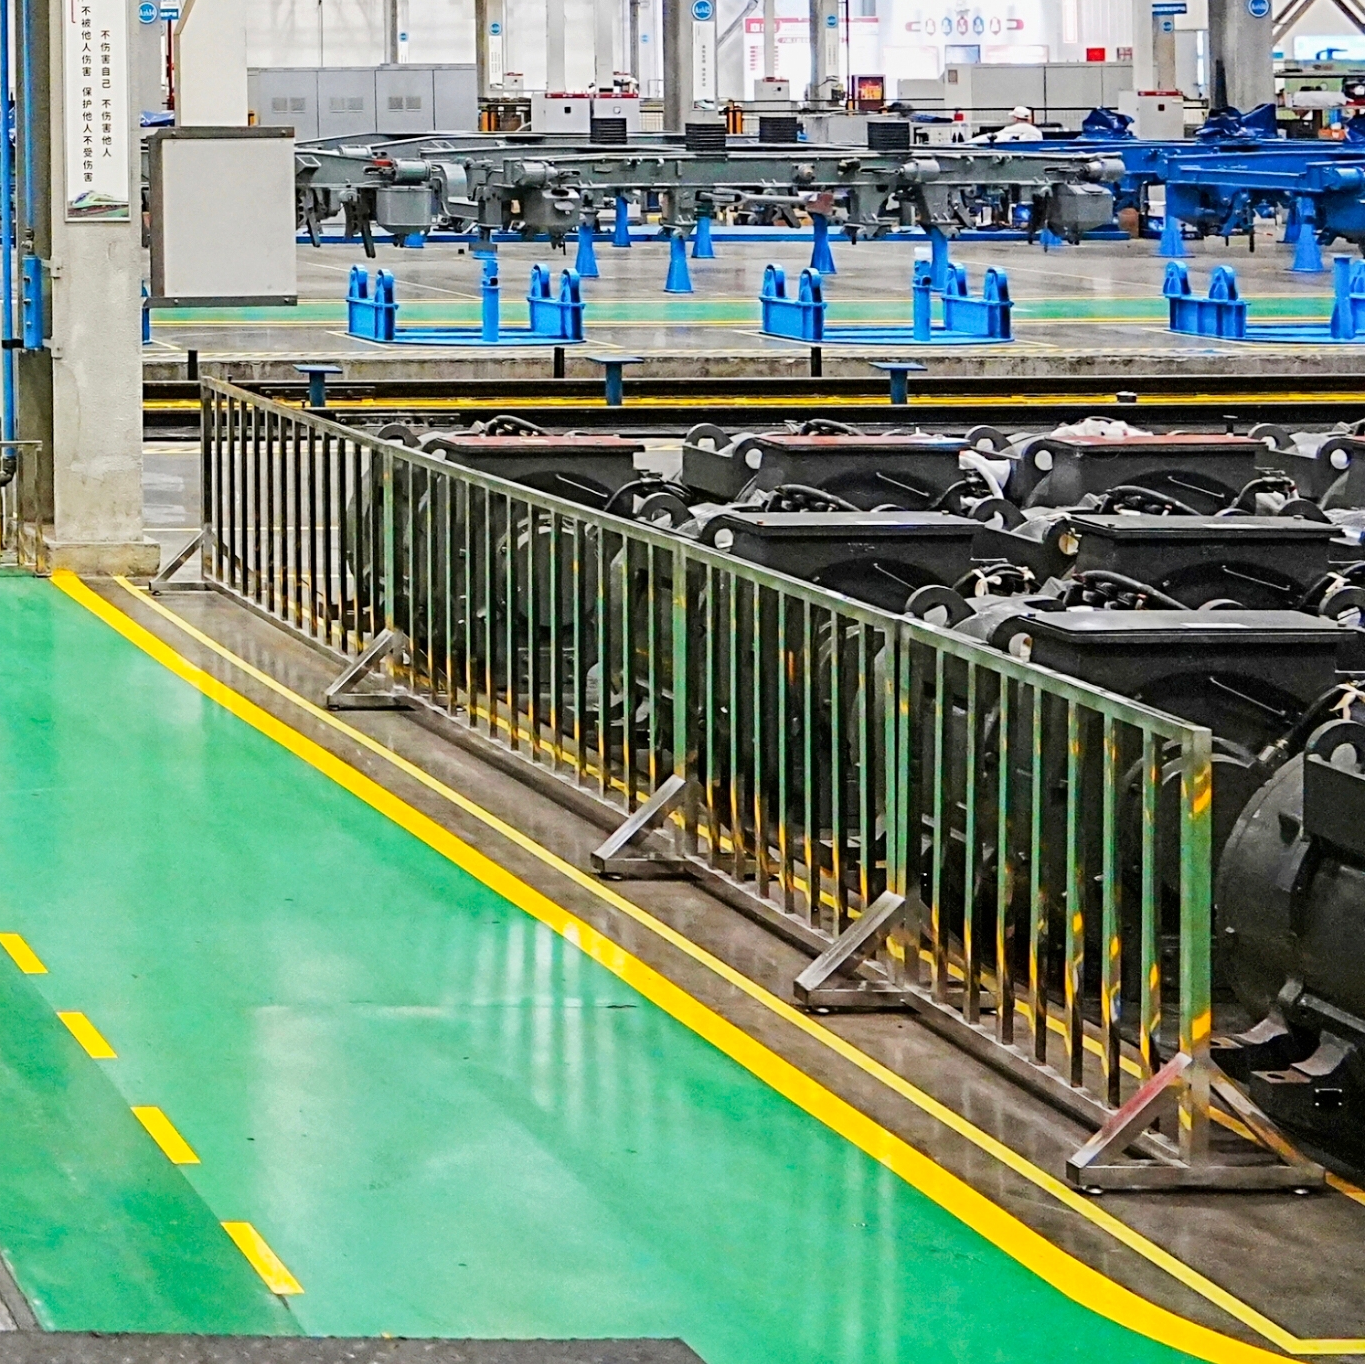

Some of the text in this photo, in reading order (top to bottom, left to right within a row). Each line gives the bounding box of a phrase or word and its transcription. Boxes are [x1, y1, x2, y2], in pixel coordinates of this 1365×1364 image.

[81, 6, 93, 183] 不被他人伤害 保护他人不受伤害
[101, 30, 112, 158] 不伤害自己 不伤害他人
